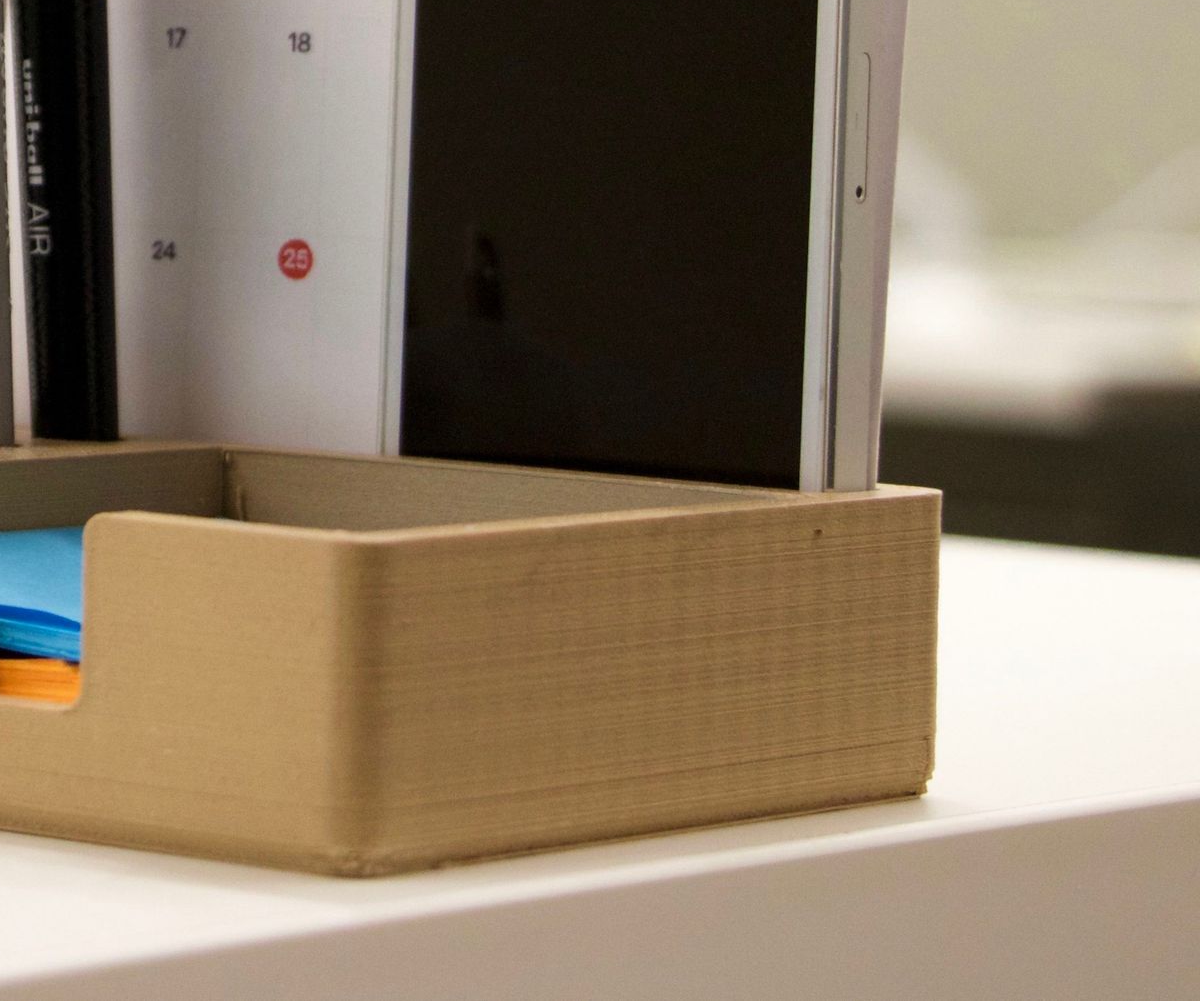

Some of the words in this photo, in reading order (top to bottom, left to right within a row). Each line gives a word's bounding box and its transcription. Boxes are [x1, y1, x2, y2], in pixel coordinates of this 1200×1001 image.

[165, 27, 188, 49] 17
[287, 31, 312, 54] 18
[27, 201, 53, 256] AIR
[151, 239, 176, 261] 24
[282, 247, 308, 270] 25
